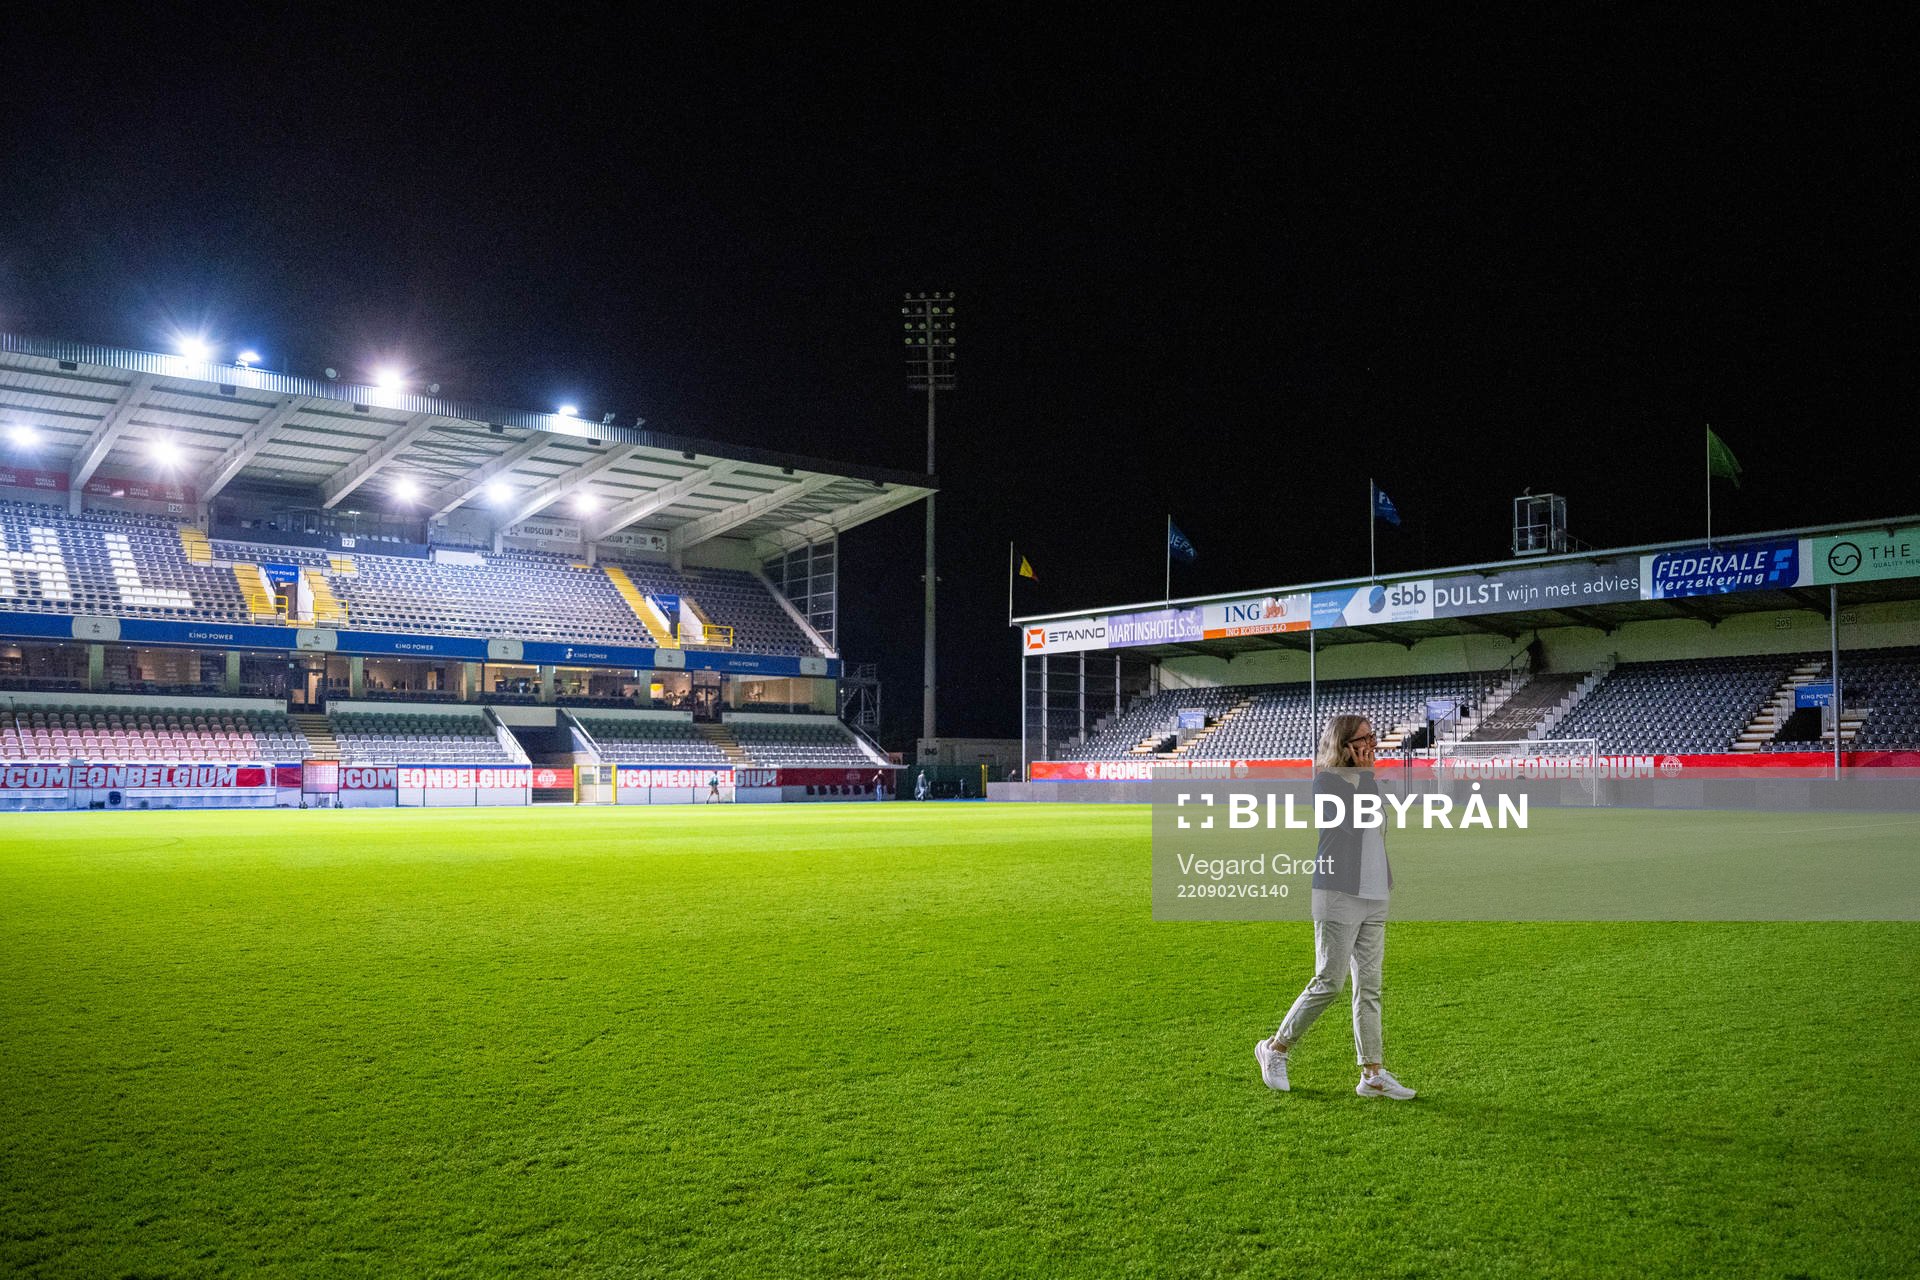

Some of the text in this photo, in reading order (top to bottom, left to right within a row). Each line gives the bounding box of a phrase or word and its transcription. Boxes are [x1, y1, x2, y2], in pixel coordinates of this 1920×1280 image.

[523, 526, 553, 536] KIDSCLUB
[1869, 543, 1912, 560] THE
[1656, 552, 1768, 578] FEDERALE
[1507, 576, 1640, 604] wijn met advies
[1655, 572, 1765, 593] Verzekering
[1391, 584, 1426, 607] sbb
[1434, 583, 1504, 609] DULST
[1224, 602, 1261, 624] ING
[209, 633, 234, 641] POWER
[1226, 627, 1240, 637] ING
[1100, 761, 1231, 780] #COMEONBELGIUM
[1453, 756, 1655, 779] #COMEONBELGIUM
